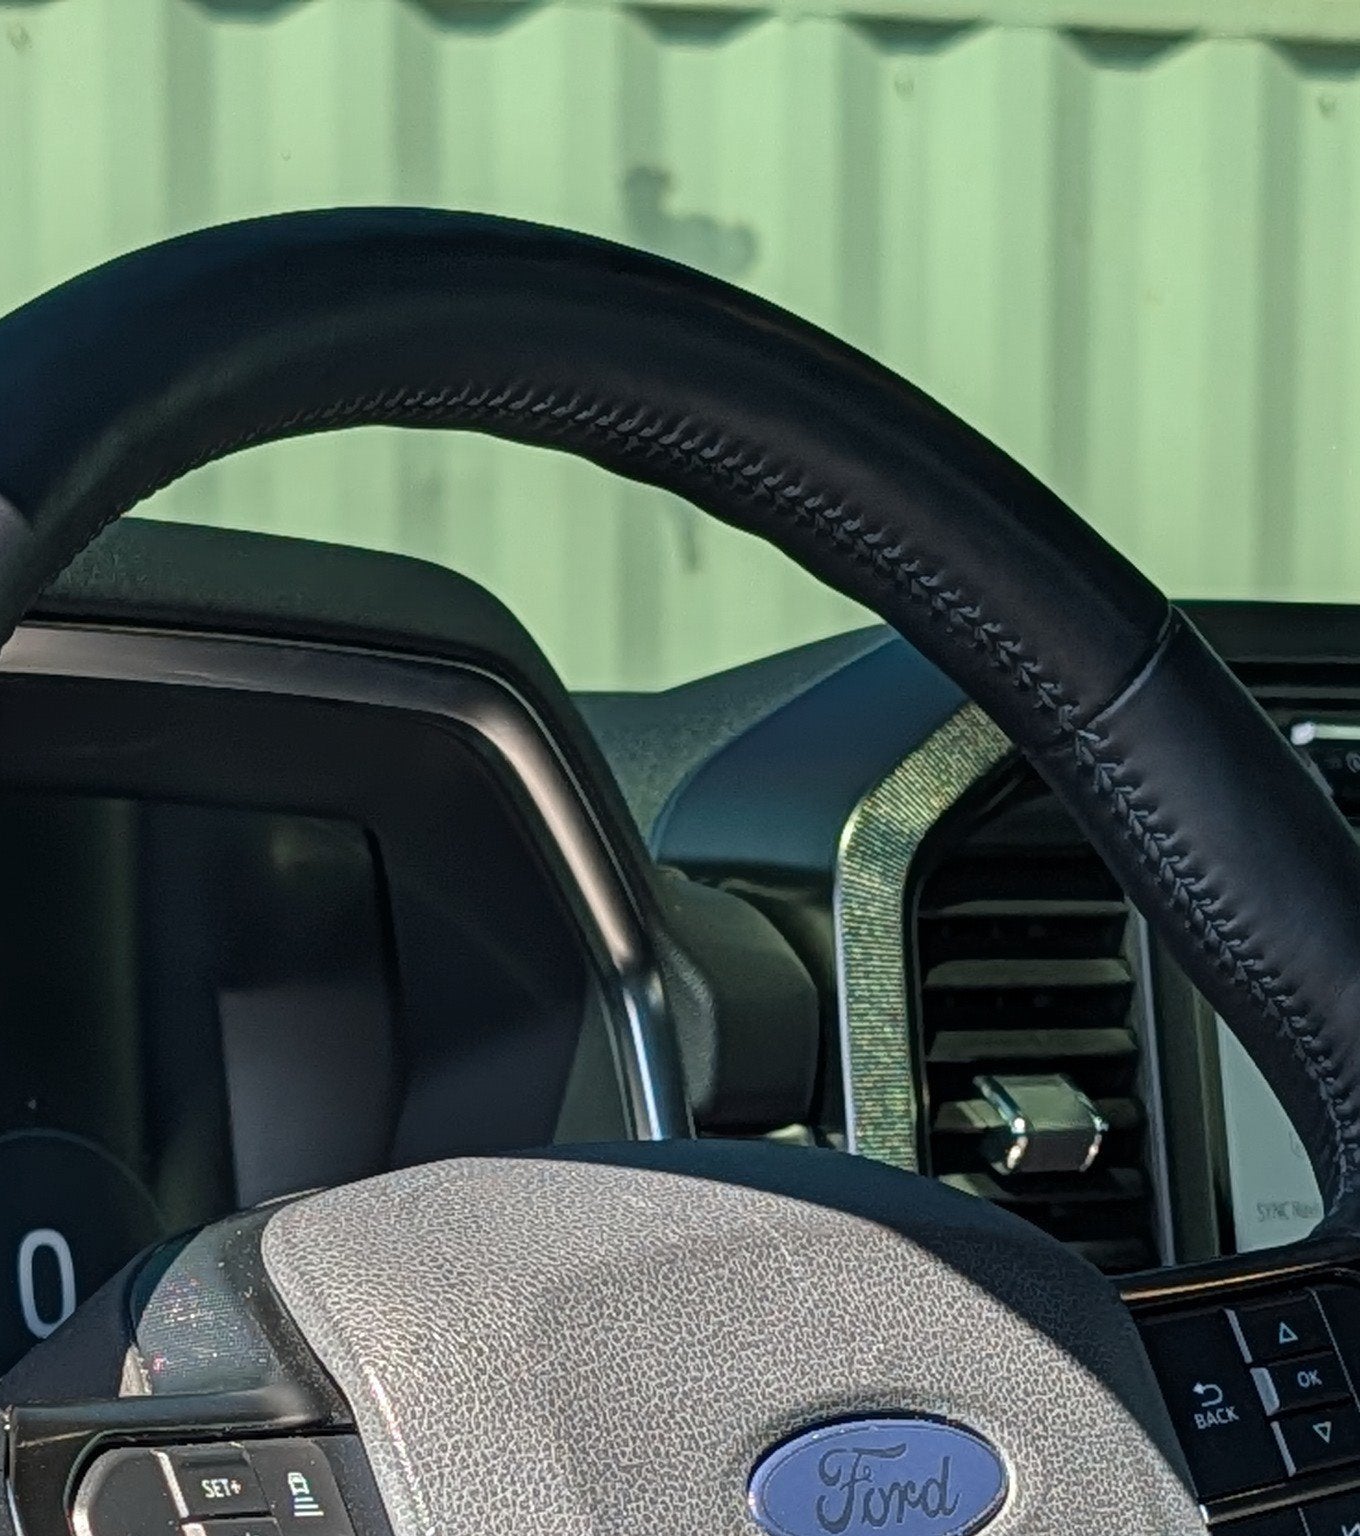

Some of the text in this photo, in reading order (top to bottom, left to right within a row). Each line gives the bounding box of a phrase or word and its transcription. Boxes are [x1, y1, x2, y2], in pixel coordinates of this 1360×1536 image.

[17, 1227, 77, 1339] 0
[1296, 1370, 1323, 1388] OK
[1193, 1406, 1240, 1430] BACK
[201, 1477, 242, 1499] SET+
[815, 1443, 960, 1534] Ford
